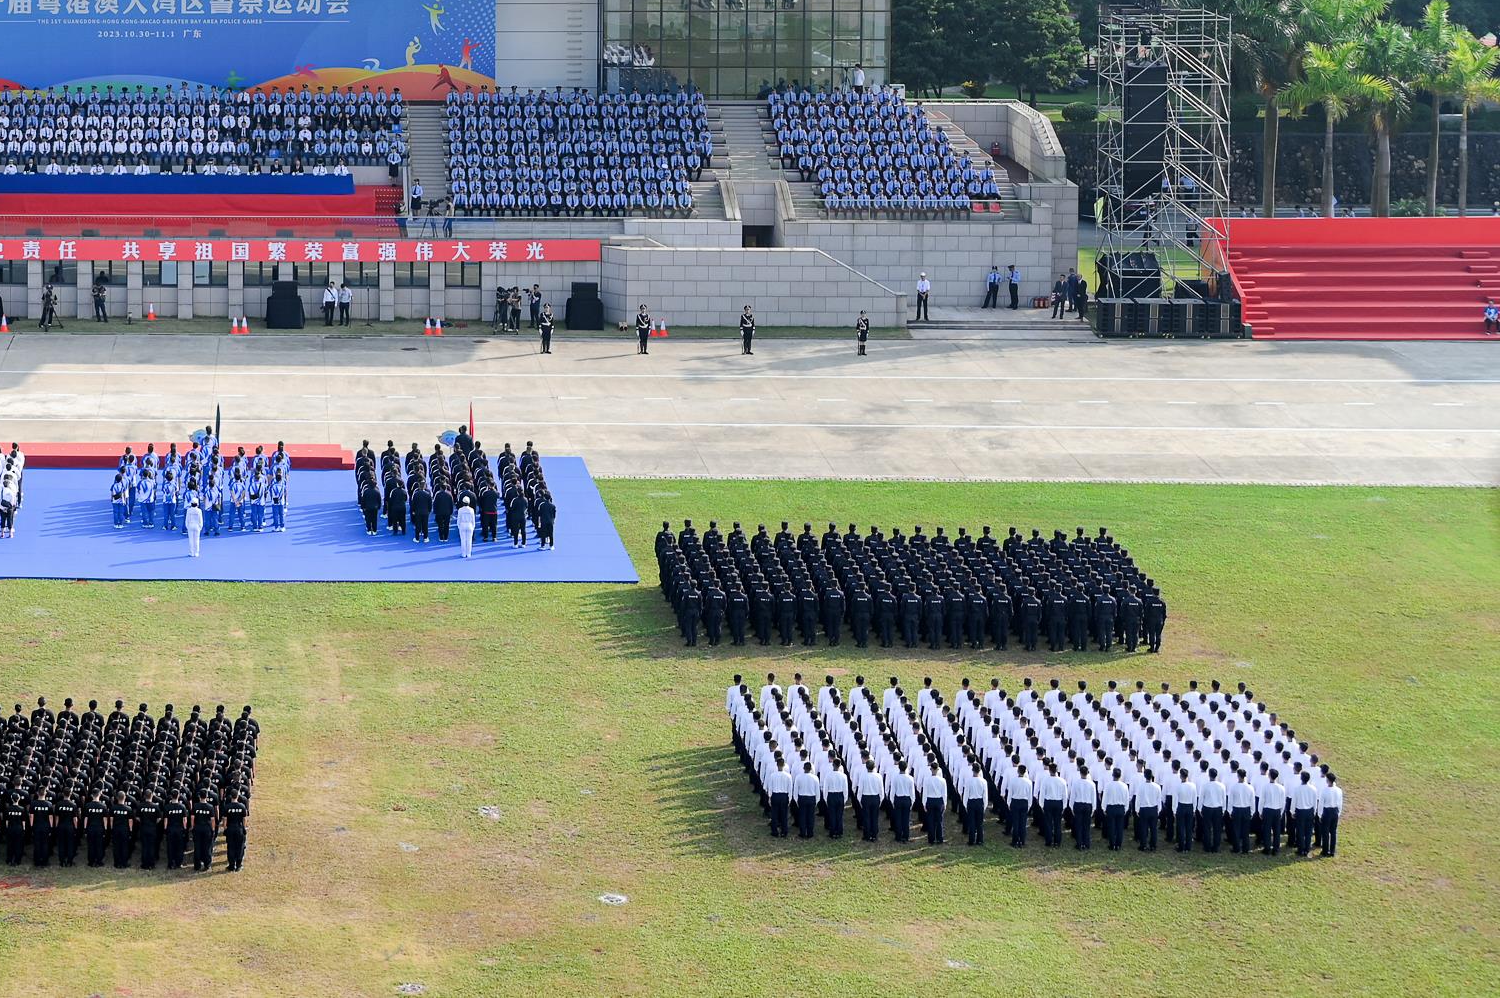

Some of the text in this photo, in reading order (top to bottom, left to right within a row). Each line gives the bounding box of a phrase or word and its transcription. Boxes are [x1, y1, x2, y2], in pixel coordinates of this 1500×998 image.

[97, 29, 202, 38] 2023.10.30-11.1 广东
[120, 240, 545, 260] 共享祖国繁荣富强伟大荣光
